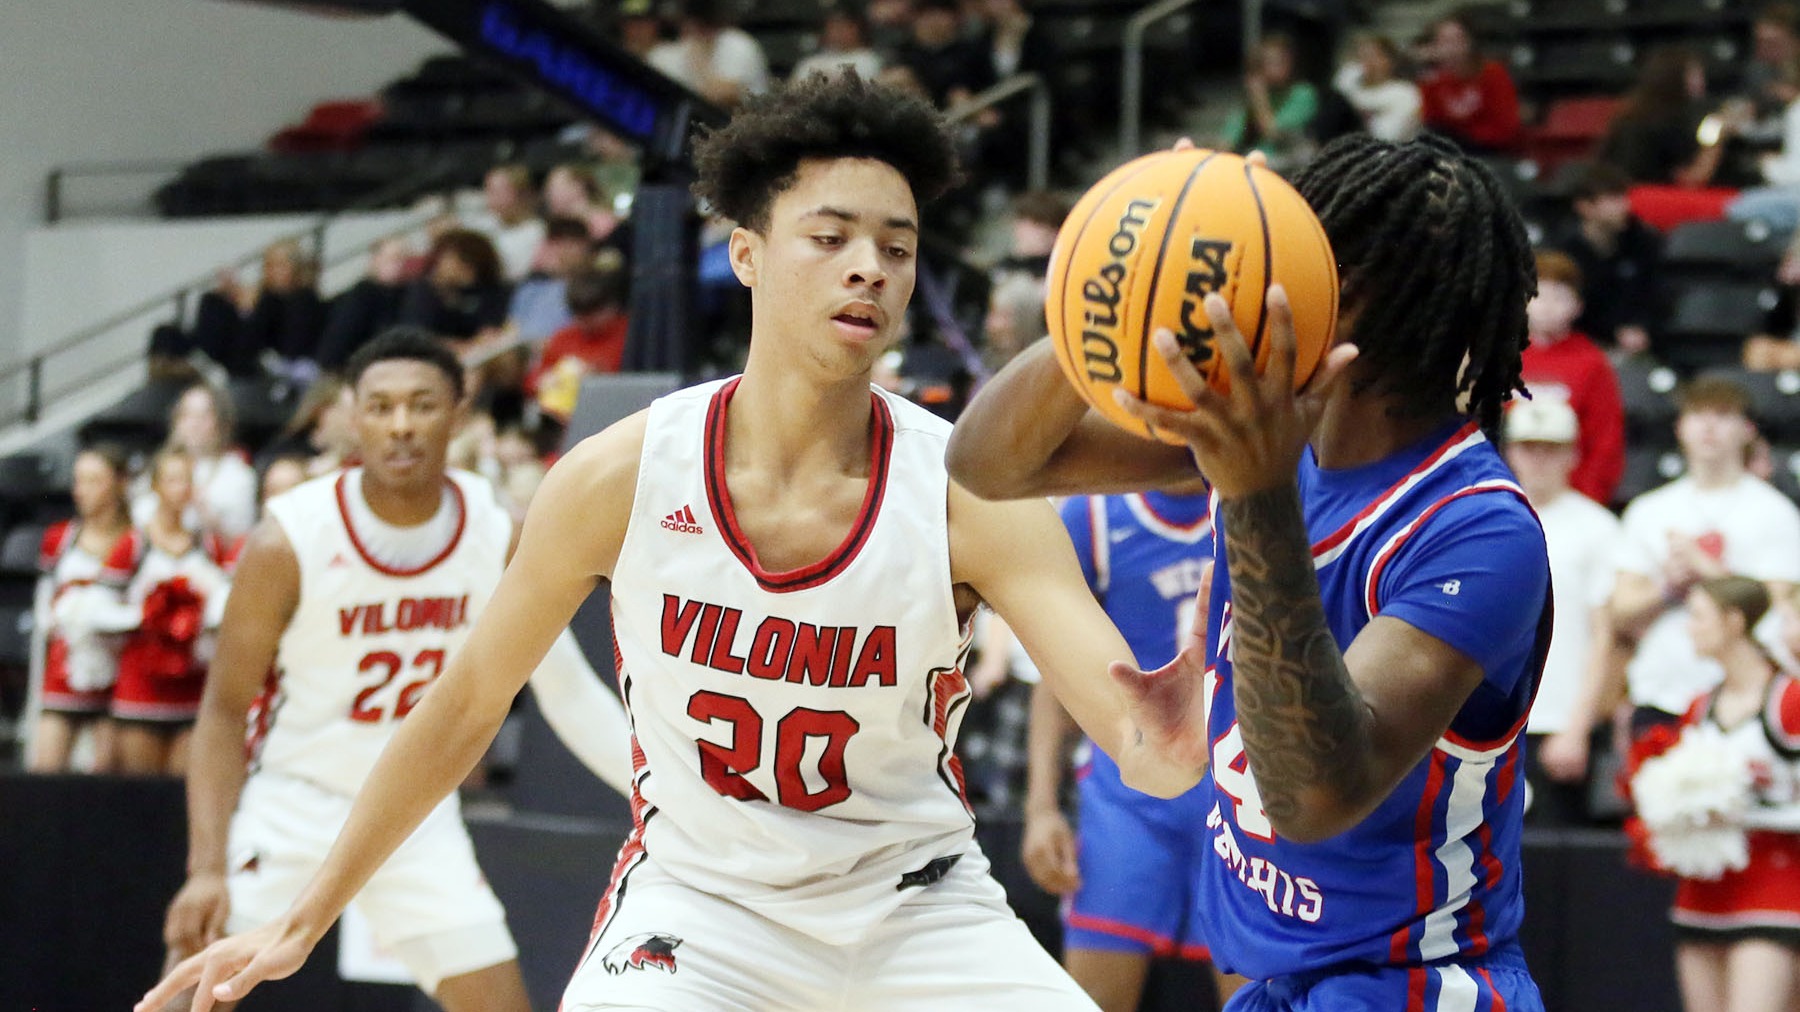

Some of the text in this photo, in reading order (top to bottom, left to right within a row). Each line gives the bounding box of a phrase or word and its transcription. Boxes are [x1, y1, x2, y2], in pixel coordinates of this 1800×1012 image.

[1082, 199, 1154, 384] Wilson
[660, 520, 703, 535] adidas
[350, 650, 447, 724] 22
[660, 593, 897, 687] VILONIA
[686, 689, 860, 812] 20
